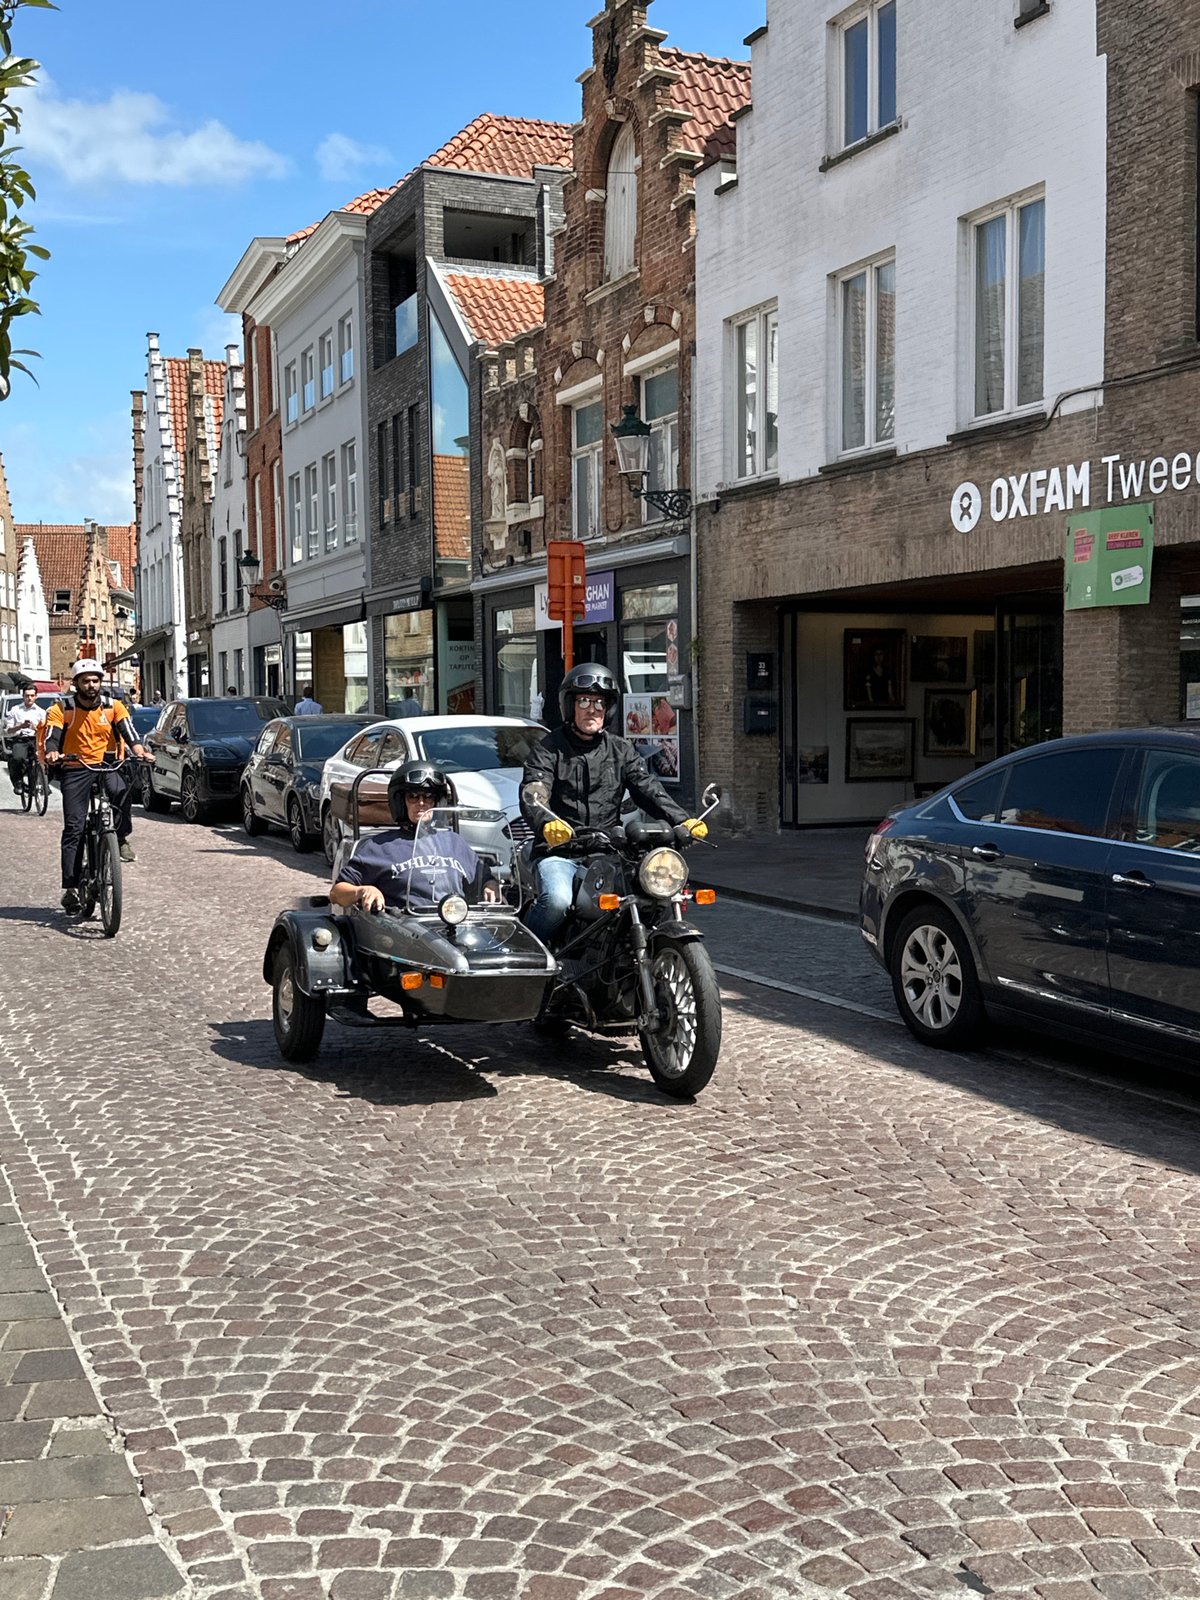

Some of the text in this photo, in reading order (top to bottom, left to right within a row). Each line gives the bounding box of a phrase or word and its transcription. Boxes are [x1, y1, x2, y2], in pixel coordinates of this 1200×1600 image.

[990, 453, 1200, 522] OXFAM Twee
[585, 583, 610, 601] GHAN
